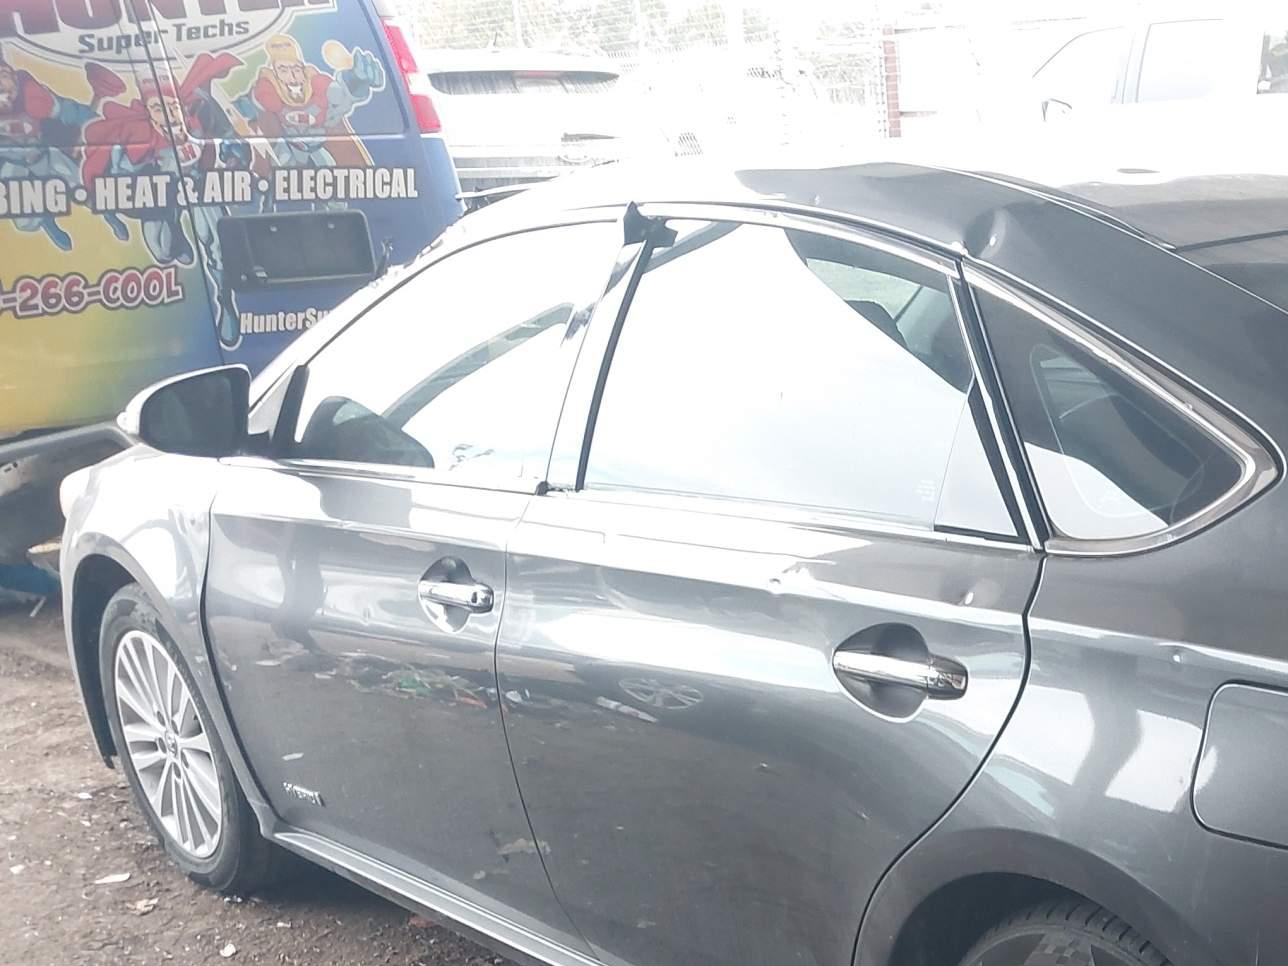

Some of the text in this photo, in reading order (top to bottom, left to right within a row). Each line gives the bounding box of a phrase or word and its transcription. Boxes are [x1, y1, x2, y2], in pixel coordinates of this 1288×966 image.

[78, 19, 250, 53] Super Techs
[95, 175, 170, 210] HEAT
[177, 177, 198, 206] &
[204, 171, 251, 203] AIR
[275, 167, 418, 200] ELECTRICAL
